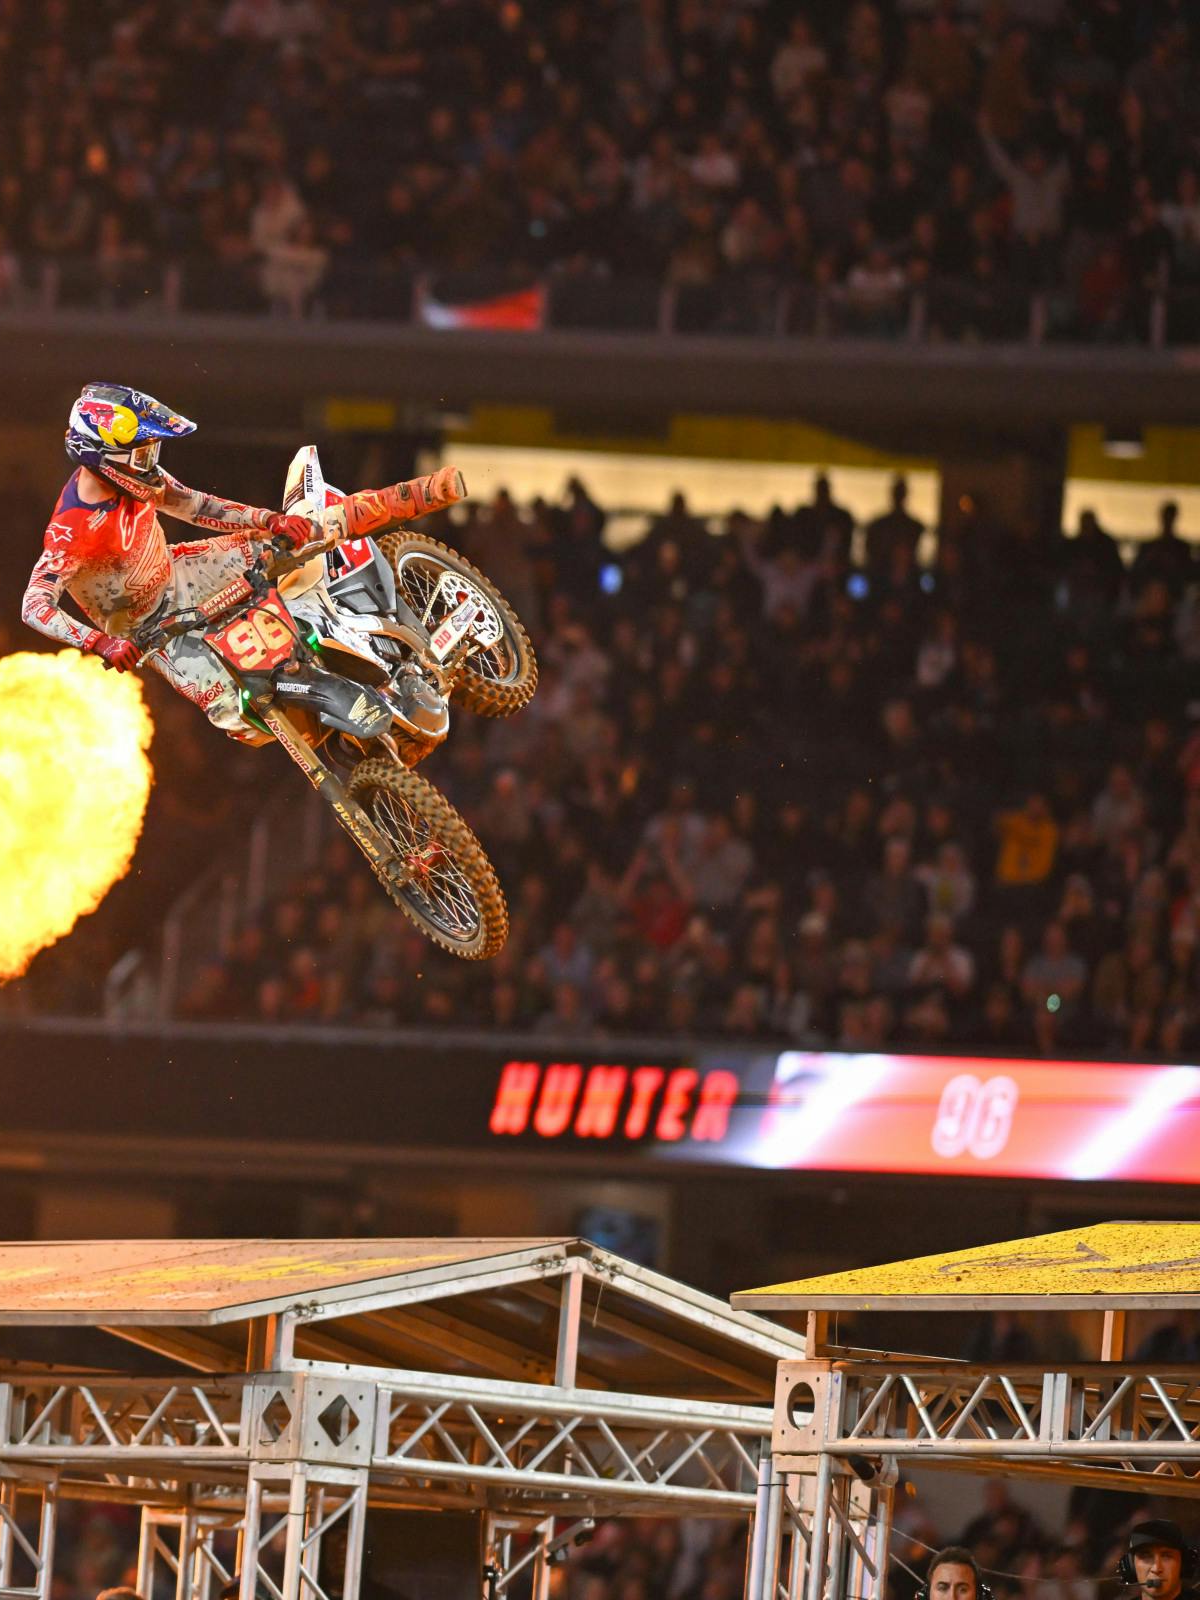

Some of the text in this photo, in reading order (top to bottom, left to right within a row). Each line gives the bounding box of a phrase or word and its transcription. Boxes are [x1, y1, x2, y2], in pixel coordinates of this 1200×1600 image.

[305, 463, 314, 493] DUNLOP
[226, 609, 293, 669] 96
[434, 629, 452, 649] DID
[332, 802, 380, 857] DUNLOP
[489, 1060, 739, 1142] HUNTER
[930, 1073, 1019, 1160] 96
